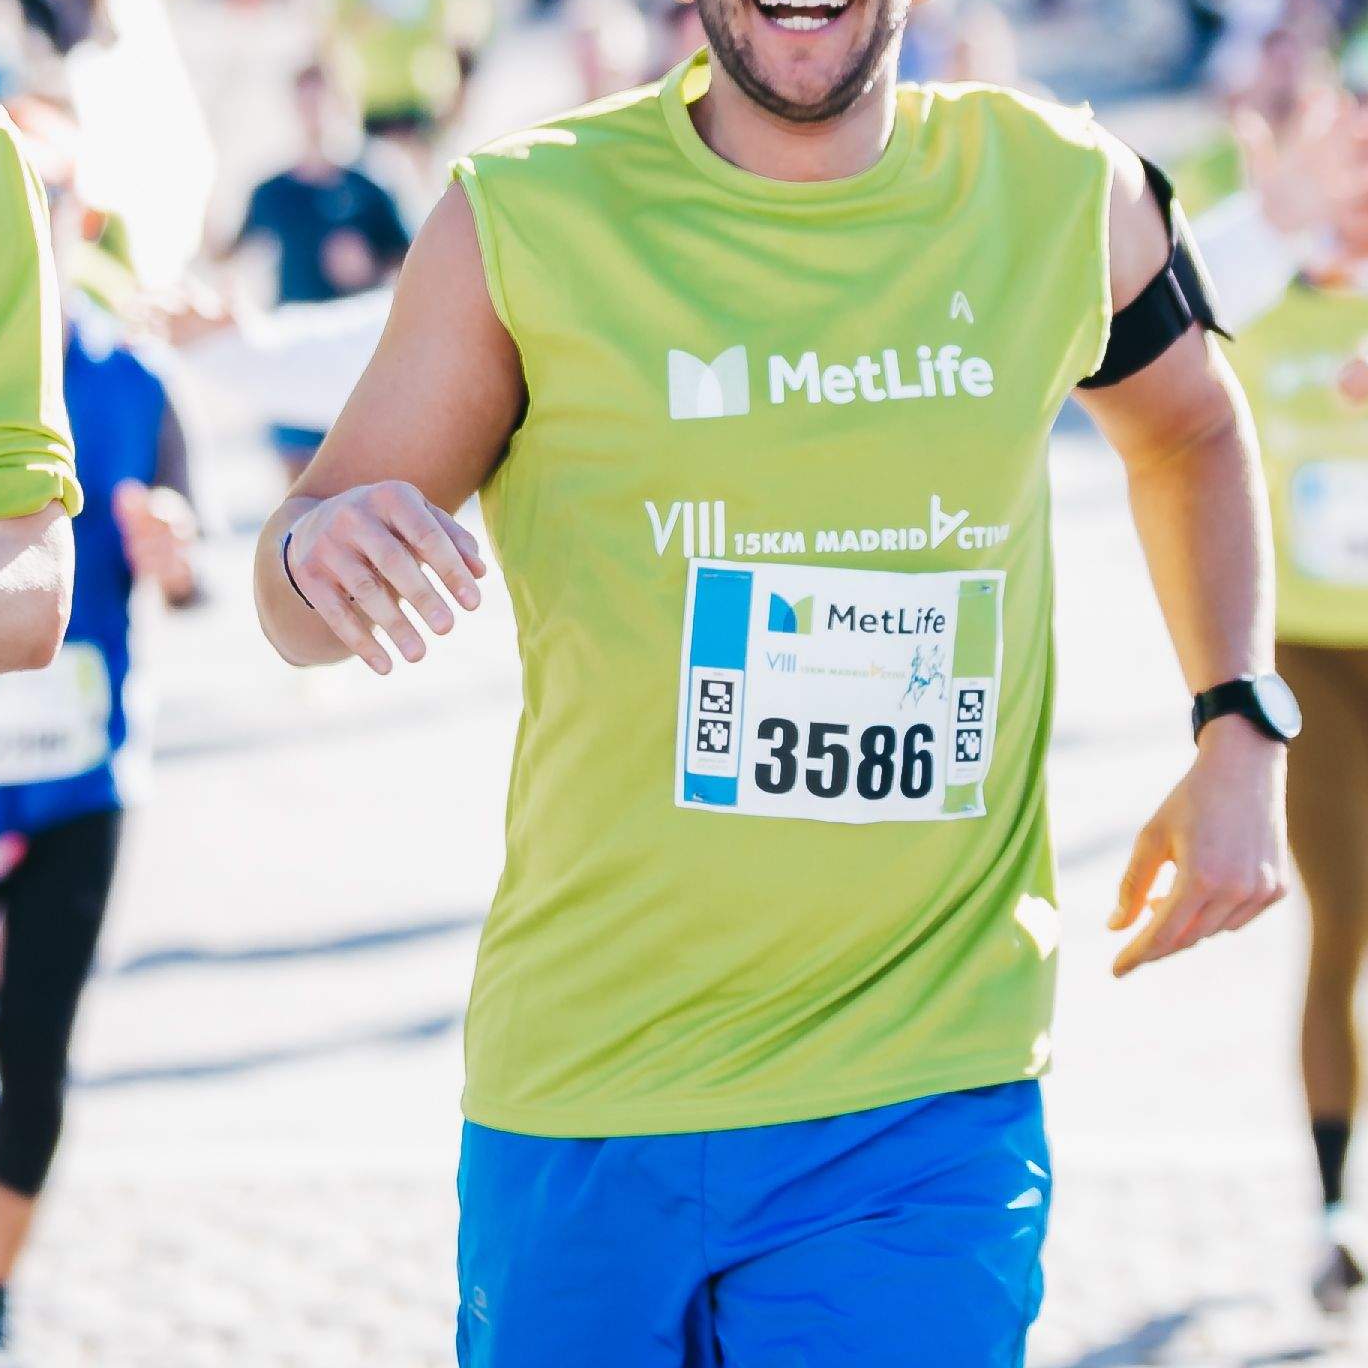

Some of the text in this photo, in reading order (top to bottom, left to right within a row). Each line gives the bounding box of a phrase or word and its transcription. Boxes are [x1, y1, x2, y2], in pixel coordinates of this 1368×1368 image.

[768, 344, 995, 405] MetLife
[644, 494, 1010, 558] VIII 15KM MADRID ACTIV
[827, 603, 946, 635] MetLife
[754, 717, 934, 801] 3586
